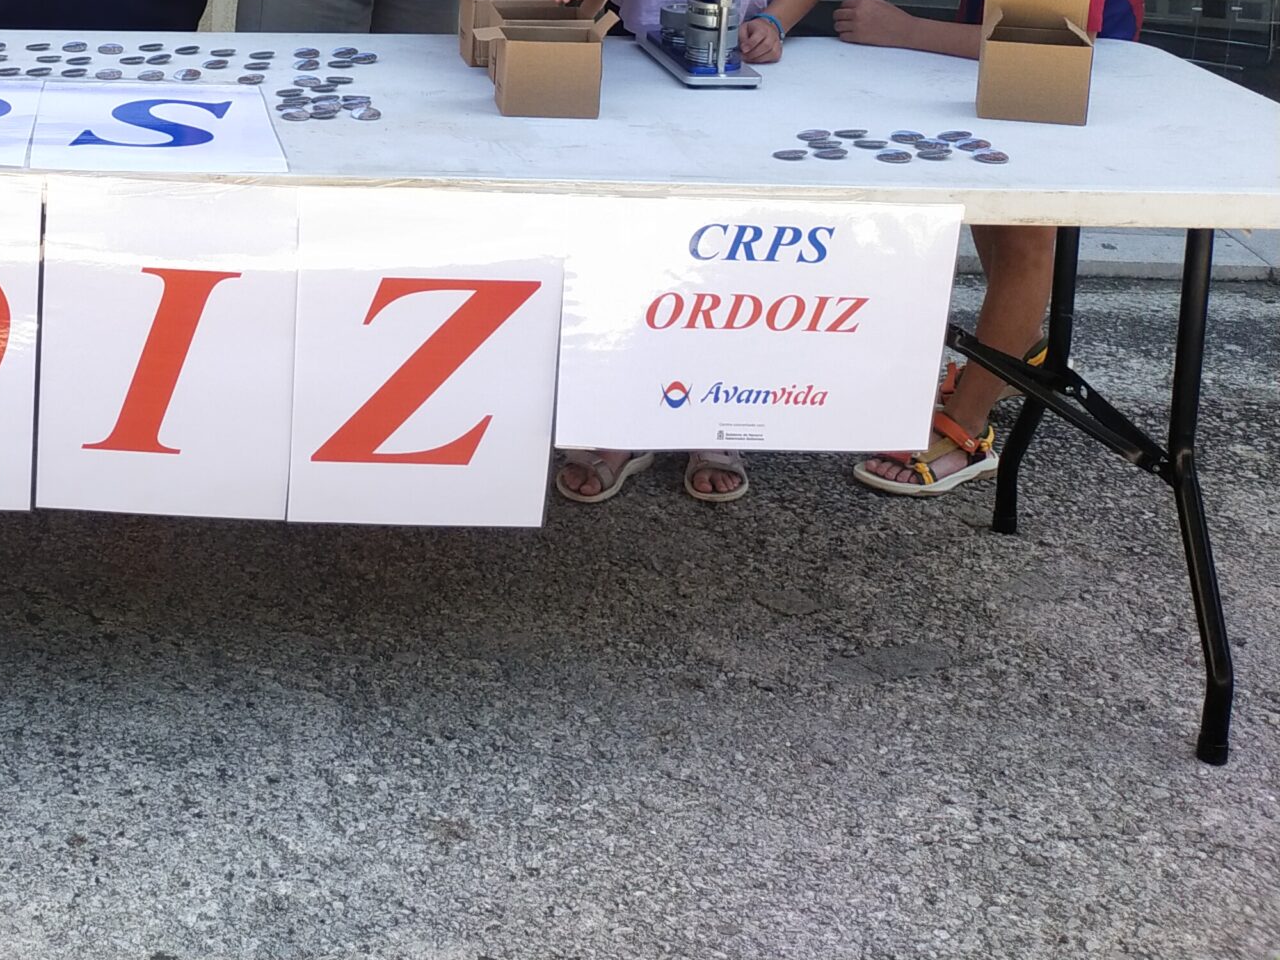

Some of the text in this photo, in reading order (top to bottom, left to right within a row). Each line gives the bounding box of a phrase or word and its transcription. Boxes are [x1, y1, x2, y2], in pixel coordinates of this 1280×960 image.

[688, 223, 836, 264] CRPS
[645, 291, 870, 333] ORDOIZ
[700, 381, 828, 407] Avanvida
